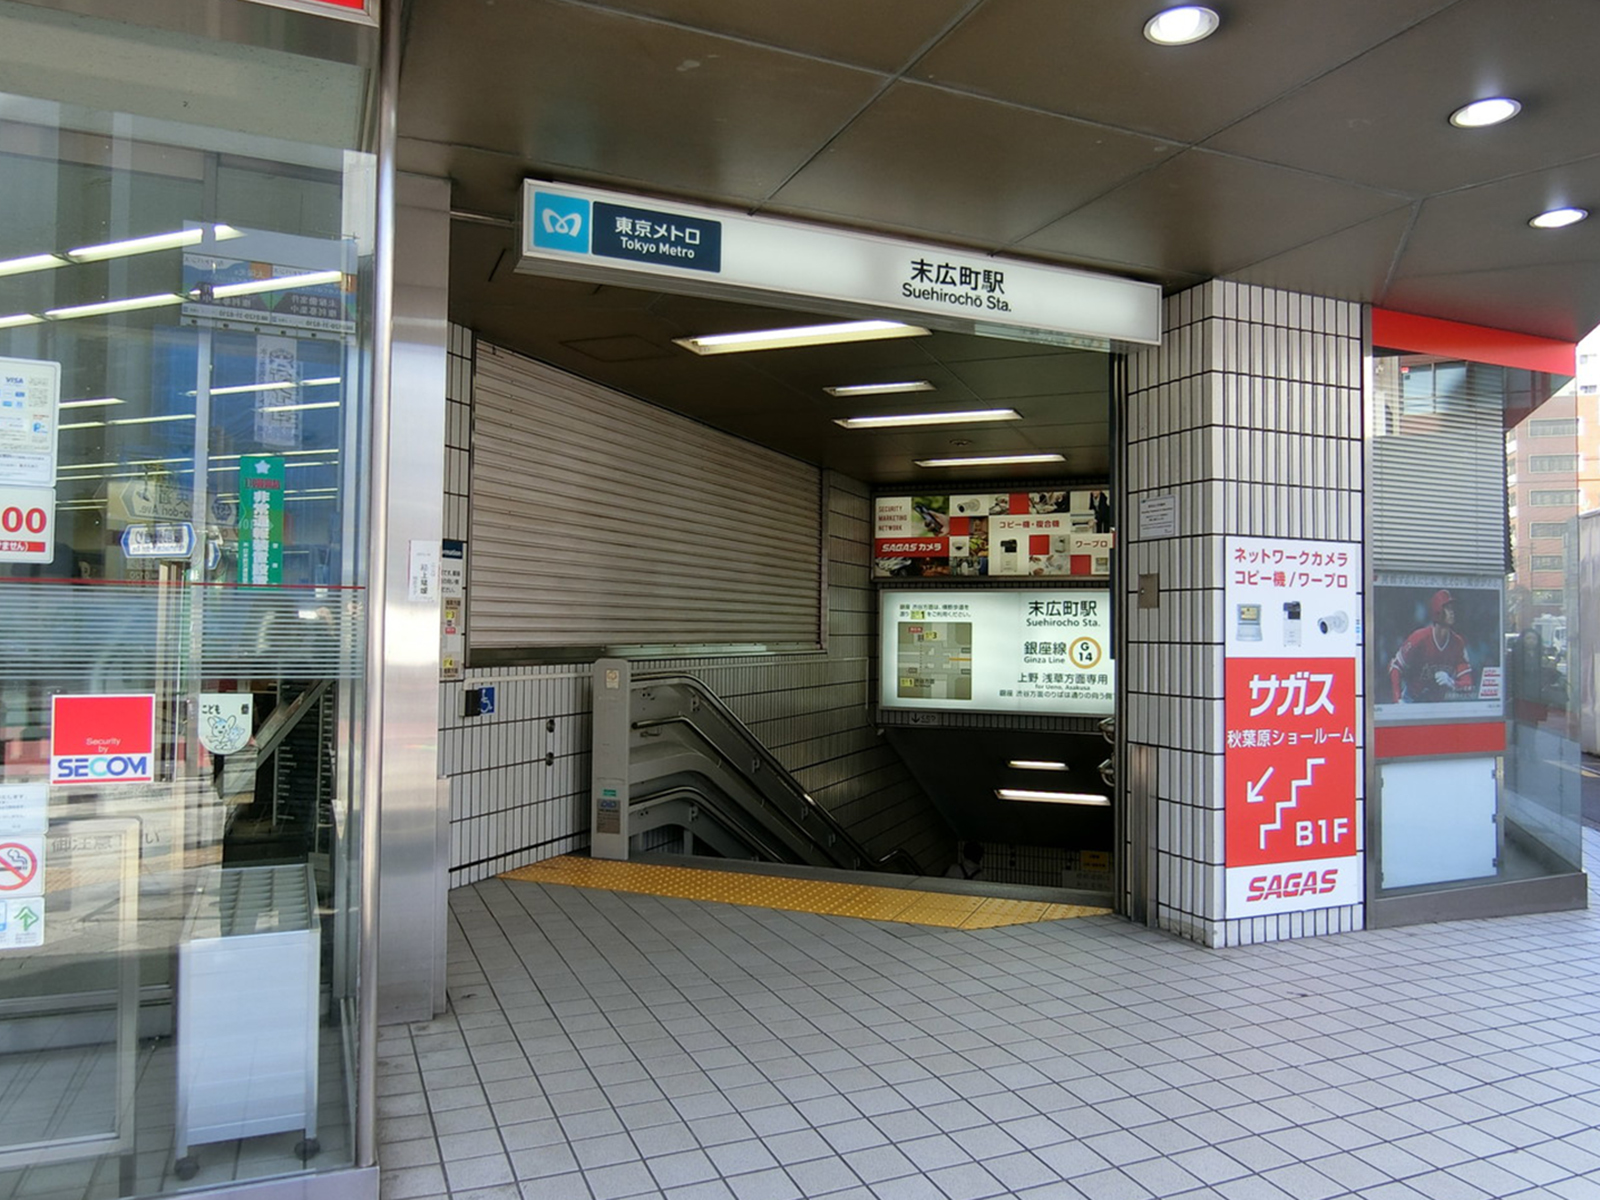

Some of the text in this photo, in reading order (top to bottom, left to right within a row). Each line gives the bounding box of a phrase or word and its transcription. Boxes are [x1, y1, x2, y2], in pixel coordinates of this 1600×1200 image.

[615, 216, 700, 245] 東京メトロ
[620, 236, 695, 259] Tokyo Metro
[911, 259, 1005, 294] 末広町駅
[986, 295, 1012, 312] Sta.
[881, 542, 942, 552] SAGAS カメラ
[1075, 540, 1108, 549] ワープロ
[1234, 547, 1347, 567] ネットワークカメラ
[1028, 600, 1098, 617] 末広町駅
[1082, 618, 1101, 628] Sta.
[1024, 641, 1067, 656] 銀座線
[1080, 641, 1090, 652] G
[1023, 656, 1066, 664] Ginza Line
[1078, 652, 1094, 662] 14
[1017, 672, 1109, 686] 上野 浅草方面専用
[1249, 671, 1335, 717] サガス
[202, 703, 221, 715] こども
[86, 737, 121, 747] Security
[1227, 727, 1355, 748] 秋葉原ショールーム
[98, 745, 109, 754] by
[58, 756, 147, 778] SECOM
[1296, 817, 1348, 847] B1F
[1246, 869, 1338, 903] SAGAS
